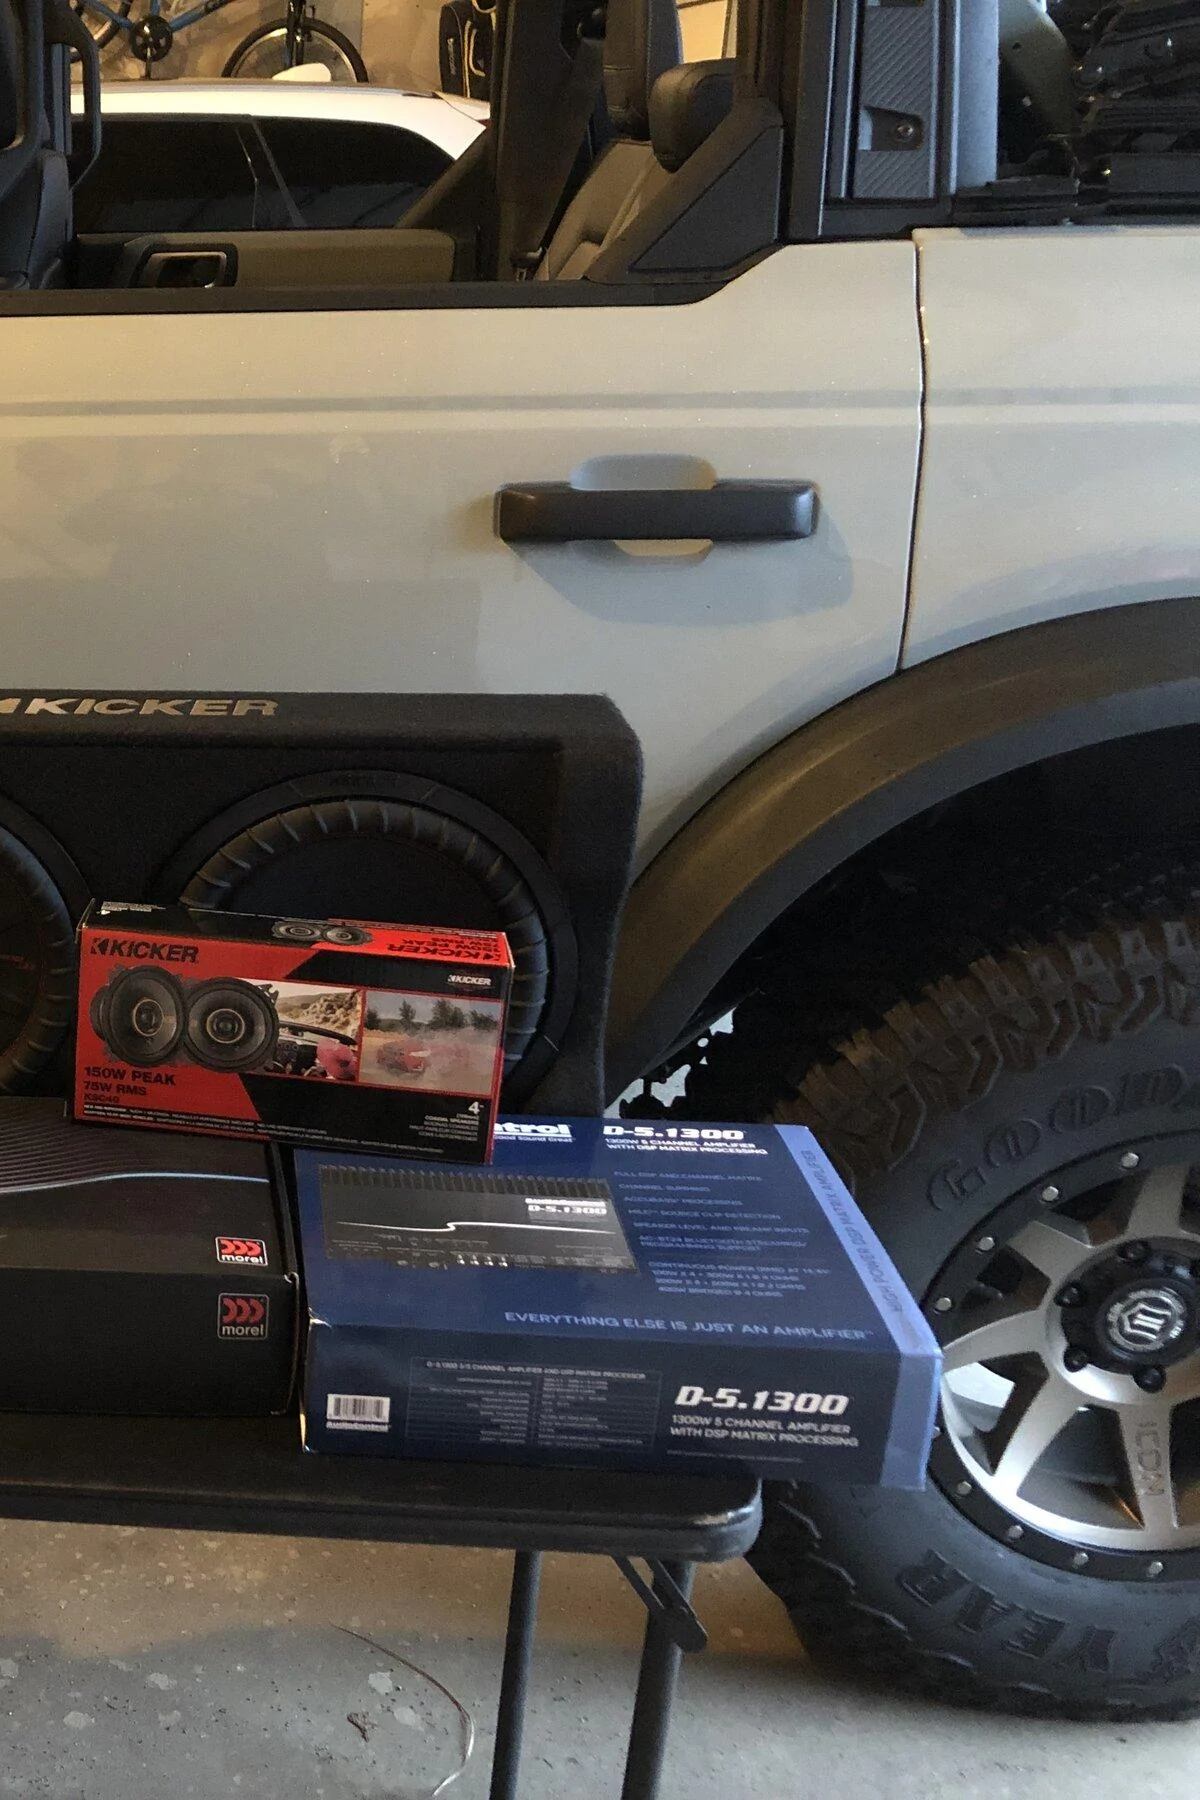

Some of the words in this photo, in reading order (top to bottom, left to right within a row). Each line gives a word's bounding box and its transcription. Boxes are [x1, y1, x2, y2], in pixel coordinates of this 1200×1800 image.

[25, 698, 279, 716] KICKER
[110, 939, 199, 963] KICKER
[387, 943, 481, 960] KICKER
[456, 976, 491, 986] KICKER
[84, 1066, 126, 1080] 150W
[131, 1070, 176, 1086] PEAK
[83, 1081, 113, 1092] 75W
[116, 1084, 147, 1096] RMS
[602, 1125, 744, 1141] D-5.1300
[650, 1139, 701, 1147] CHANNEL
[702, 1141, 756, 1149] AMPLIFIER
[700, 1147, 769, 1155] PROCESSING
[844, 1226, 866, 1244] DSP
[222, 1254, 263, 1264] morel
[855, 1247, 888, 1282] POWER
[222, 1324, 264, 1336] morel
[504, 1312, 620, 1327] EVERYTHING
[623, 1318, 668, 1330] ELSE
[670, 1320, 688, 1331] IS
[691, 1322, 733, 1333] JUST
[741, 1323, 768, 1335] AN
[472, 1363, 506, 1372] CHANNEL
[674, 1385, 850, 1415] D-5.1300
[672, 1414, 710, 1426] 1300W
[714, 1416, 723, 1426] 5
[724, 1417, 784, 1430] CHANNEL
[787, 1421, 851, 1434] AMPLIFIER
[670, 1427, 701, 1437] WITH
[704, 1428, 729, 1438] DSP
[731, 1430, 776, 1442] MATRIX
[778, 1433, 859, 1447] PROCESSING
[1135, 1420, 1165, 1496] ICON
